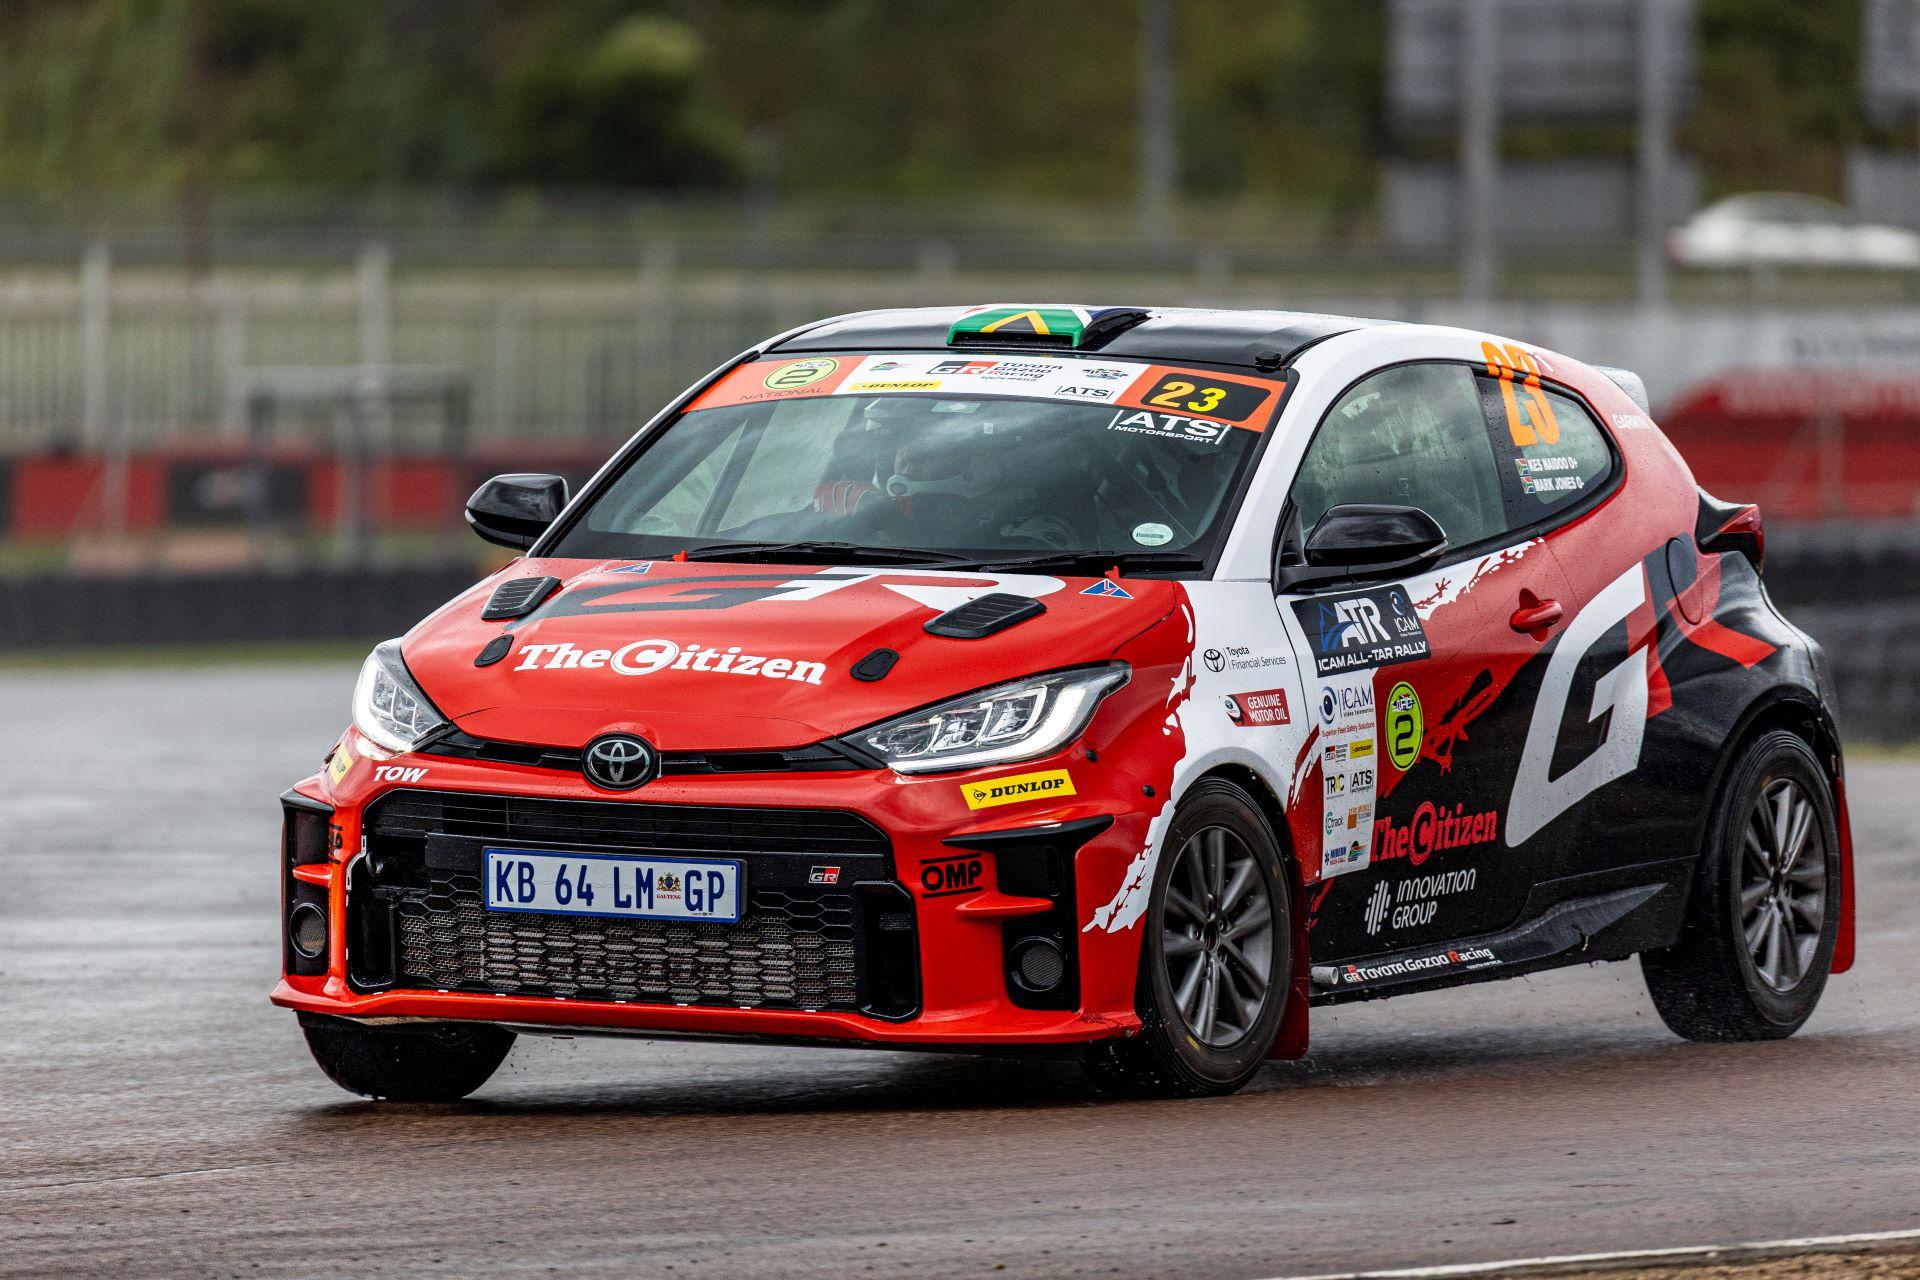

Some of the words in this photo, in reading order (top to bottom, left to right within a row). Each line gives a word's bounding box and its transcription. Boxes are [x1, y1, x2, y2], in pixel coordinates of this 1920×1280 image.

[775, 368, 818, 385] 2
[930, 365, 987, 375] GR
[739, 387, 826, 401] NATIONAL
[867, 382, 935, 390] DUNLOP
[1060, 386, 1110, 397] ATS
[1150, 381, 1227, 412] 23
[1119, 411, 1222, 437] ATS
[1114, 425, 1214, 444] MOTORSPORT
[1533, 477, 1556, 492] MARK
[1554, 476, 1577, 490] JONES
[1226, 646, 1250, 657] Toyota
[1317, 655, 1346, 672] ICAM
[1346, 646, 1394, 667] ALL-TAR
[1395, 640, 1427, 658] RALLY
[1231, 657, 1261, 670] Financial
[1260, 656, 1287, 667] Services
[1247, 693, 1282, 709] GENUINE
[1248, 709, 1275, 723] MOTOR
[1274, 707, 1288, 721] OIL
[1394, 713, 1414, 756] 2
[373, 765, 429, 783] TOW
[1351, 769, 1373, 788] ATS
[990, 778, 1065, 798] DUNLOP
[920, 860, 983, 891] OMP
[495, 860, 536, 904] KB
[554, 864, 595, 907] 64
[613, 866, 654, 910] LM
[684, 869, 726, 913] GP
[655, 893, 682, 901] GAUTENG
[1391, 900, 1438, 930] GROUP
[1357, 961, 1407, 980] TOYOTA
[1447, 947, 1495, 965] Racing
